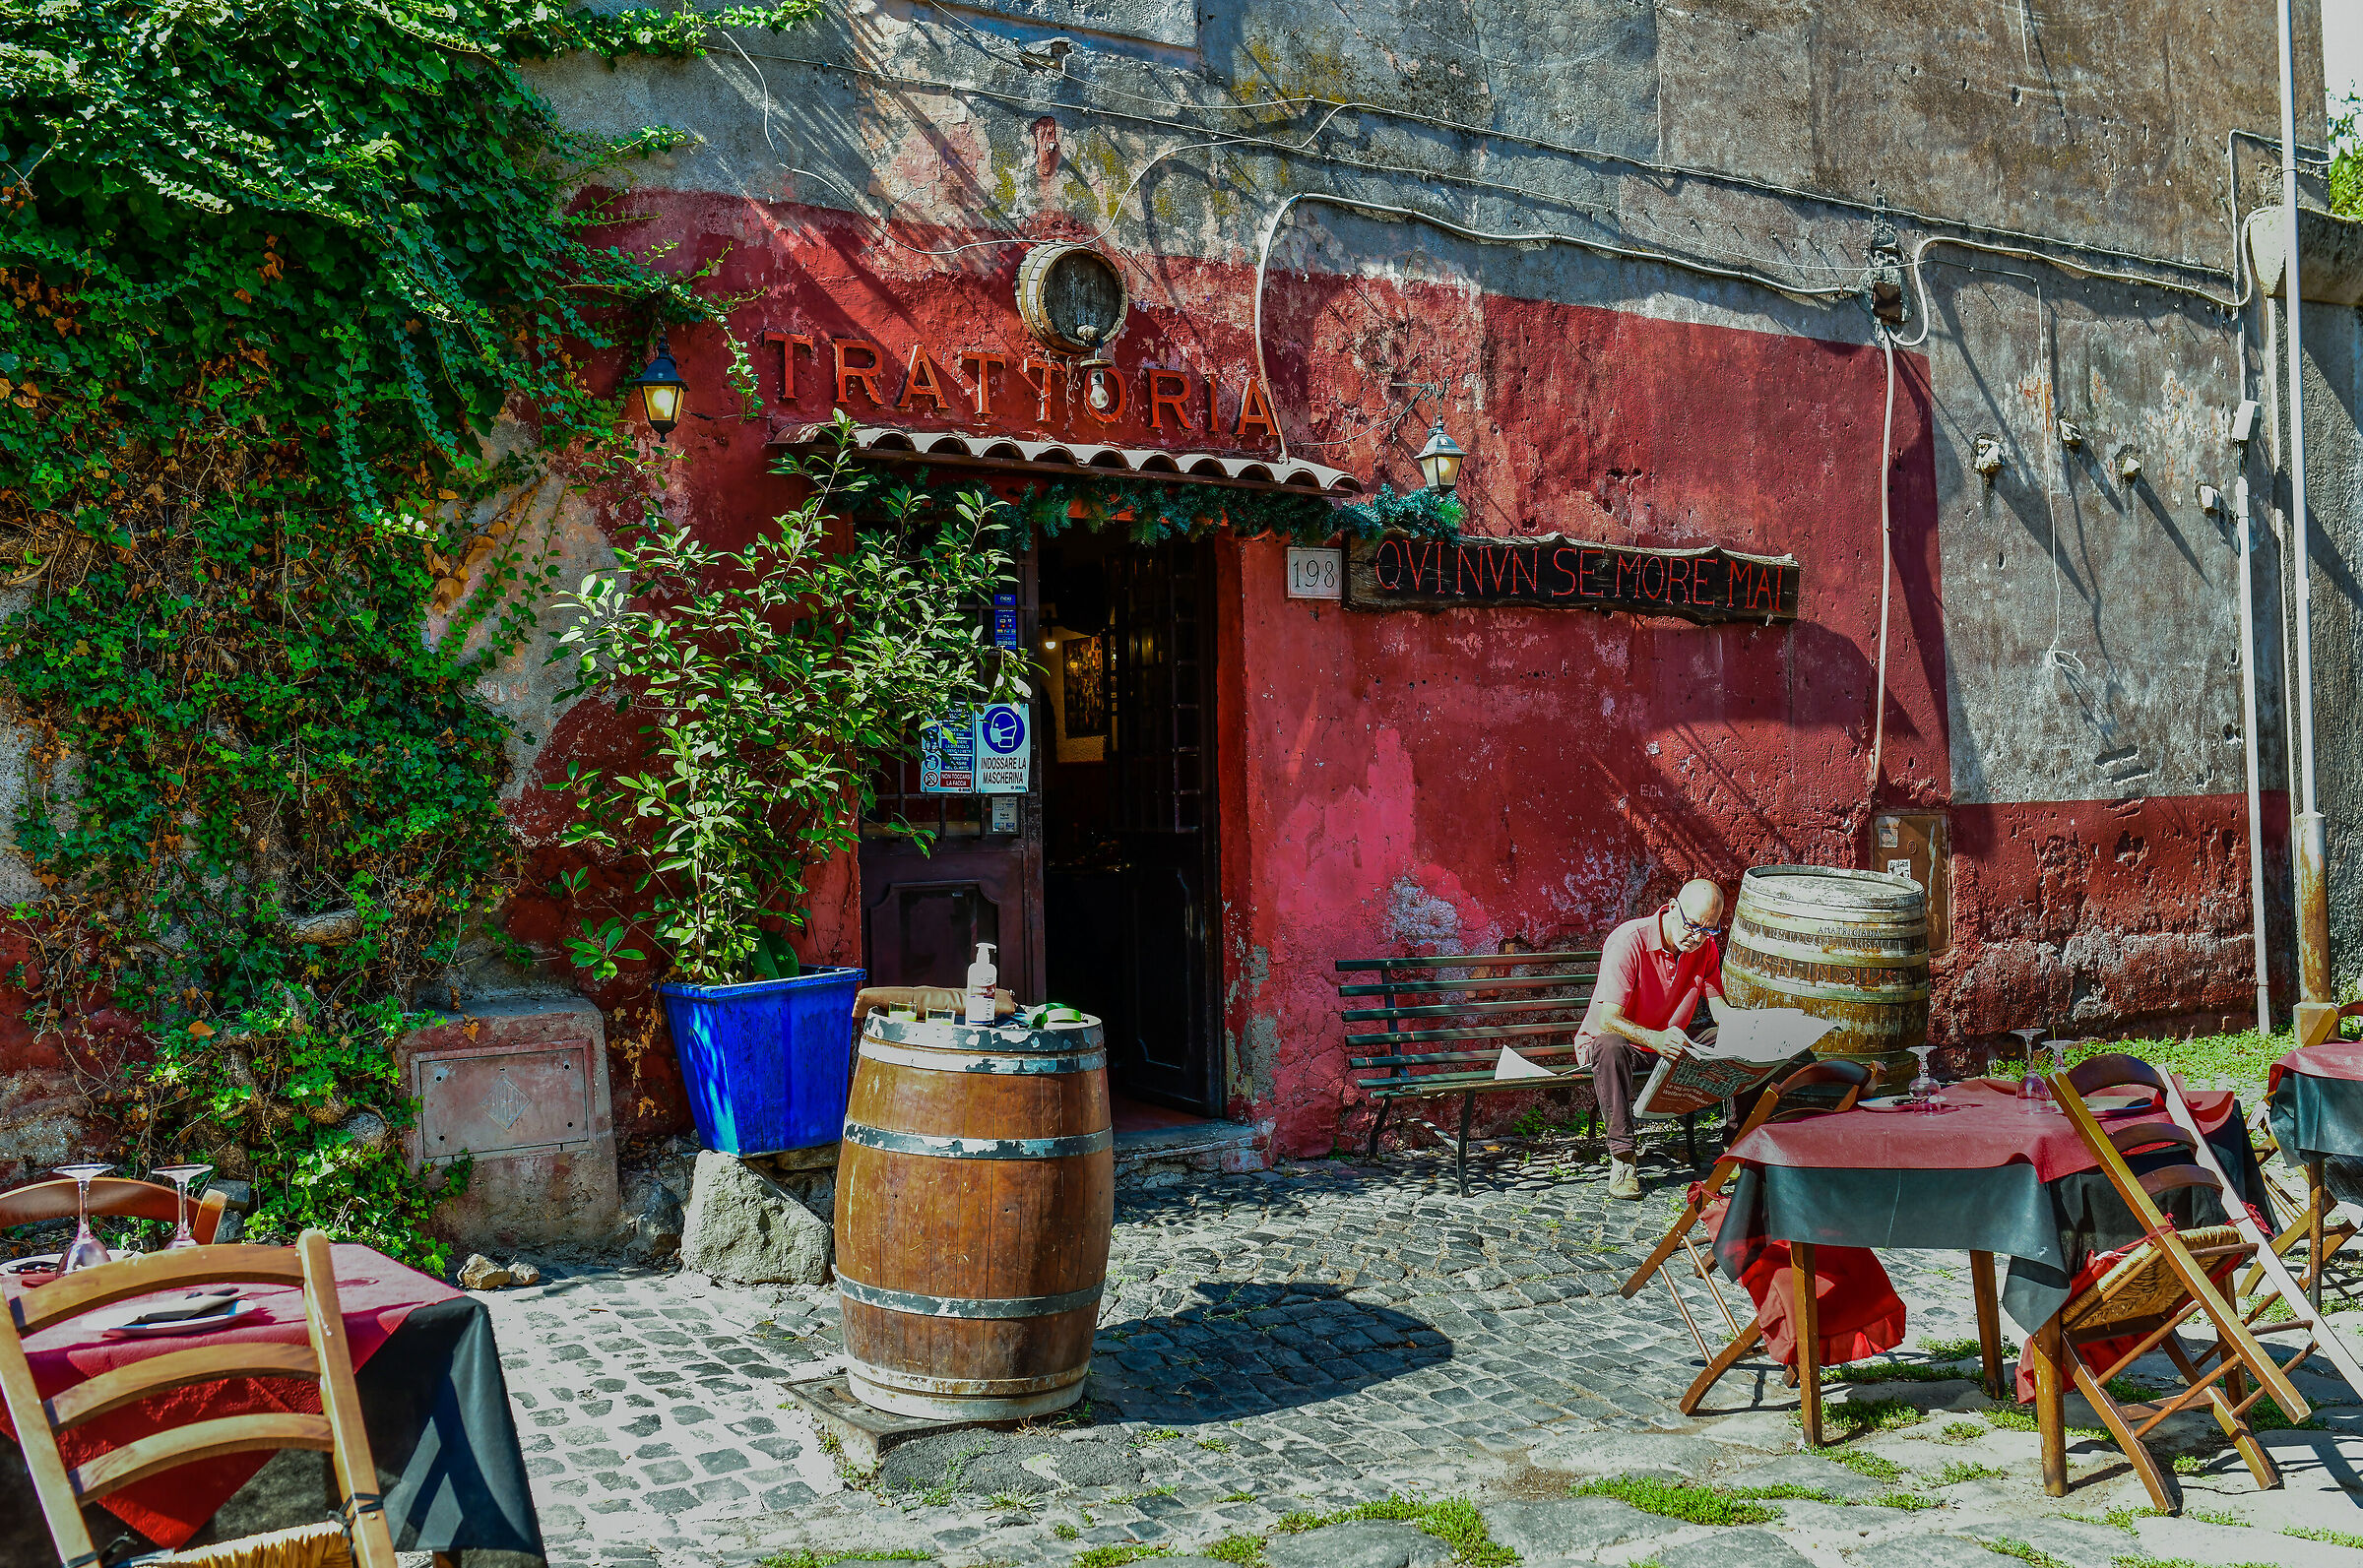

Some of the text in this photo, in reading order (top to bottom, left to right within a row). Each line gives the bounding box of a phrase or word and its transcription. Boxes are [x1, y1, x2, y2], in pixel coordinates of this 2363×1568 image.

[763, 331, 1281, 436] TRATTORIA
[1293, 559, 1335, 589] 198
[1375, 539, 1786, 612] QVI NVN SE MORE MAI
[981, 757, 1017, 770] INDOSSARE
[1018, 757, 1027, 770] LA
[982, 771, 1024, 784] MASCHERINA
[1818, 925, 1882, 938] AMATRICIANA
